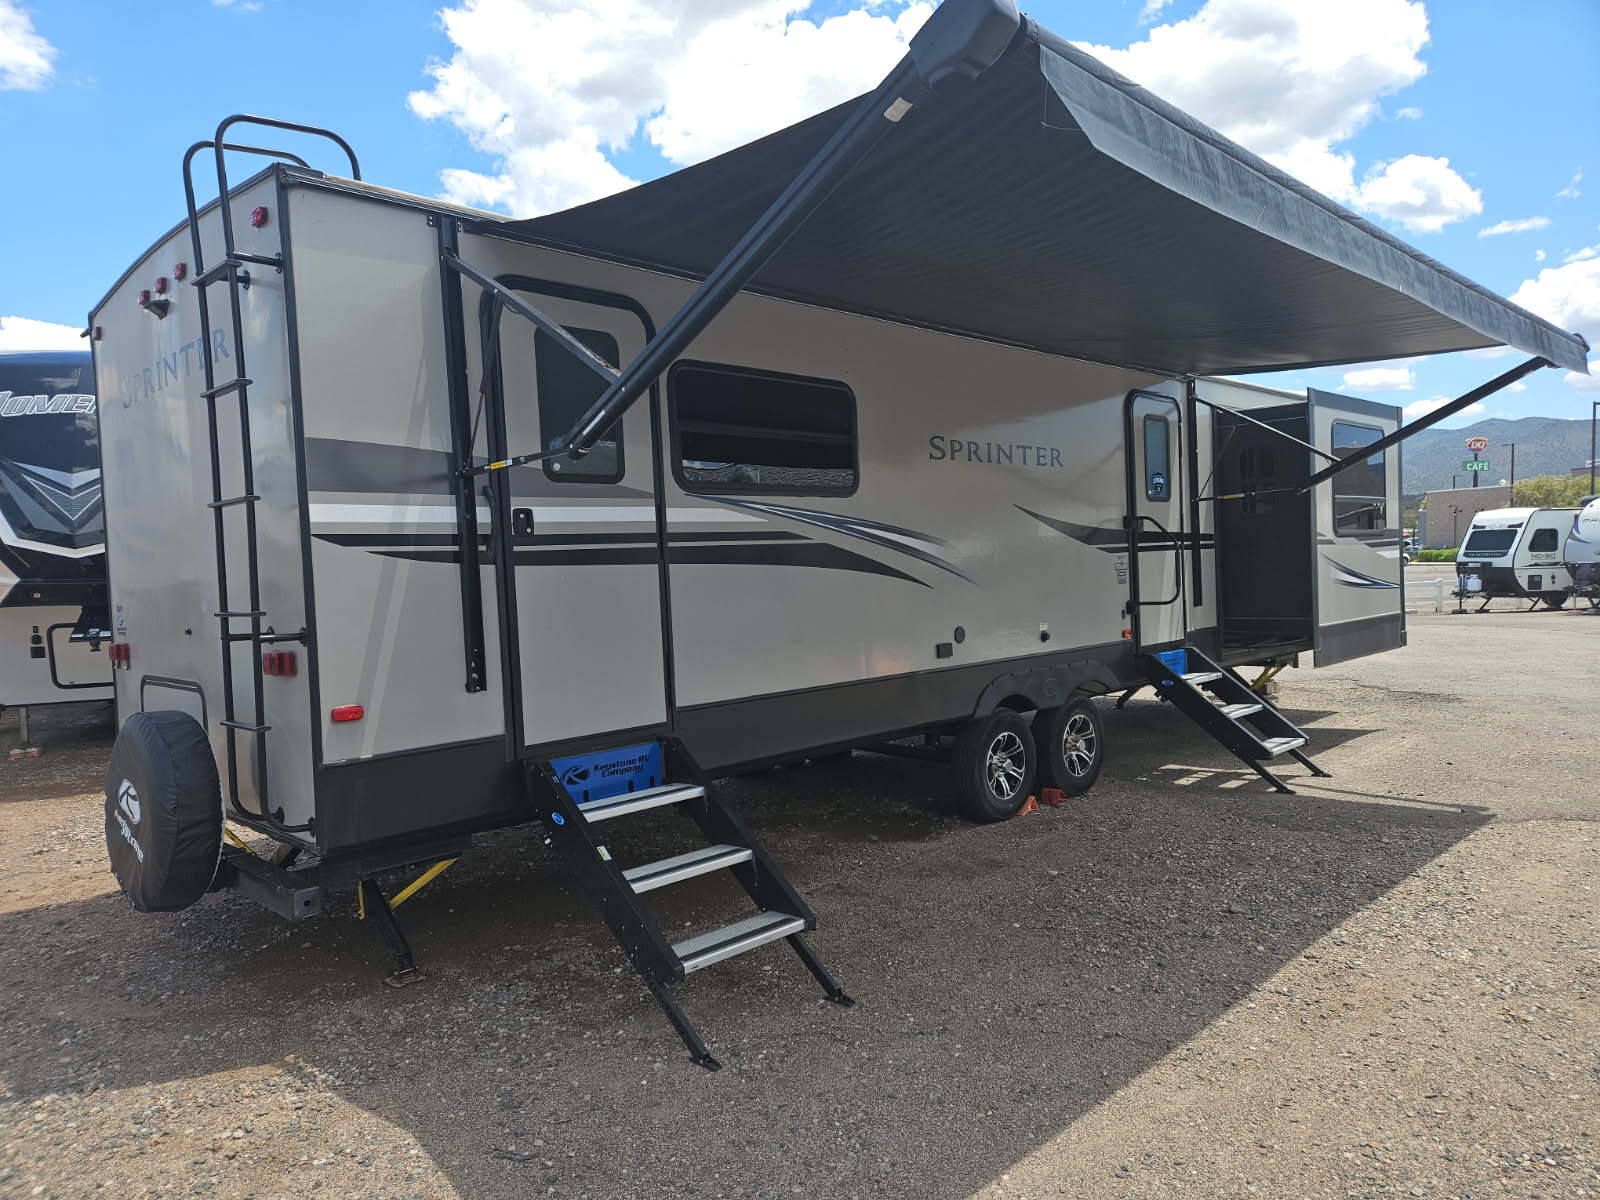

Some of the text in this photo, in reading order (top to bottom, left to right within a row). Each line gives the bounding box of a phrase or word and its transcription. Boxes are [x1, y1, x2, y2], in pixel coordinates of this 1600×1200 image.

[929, 435, 1064, 468] SPRINTER
[1471, 441, 1487, 449] DQ
[1466, 463, 1489, 471] CAFE
[593, 758, 637, 772] Keystone
[601, 764, 644, 778] Company
